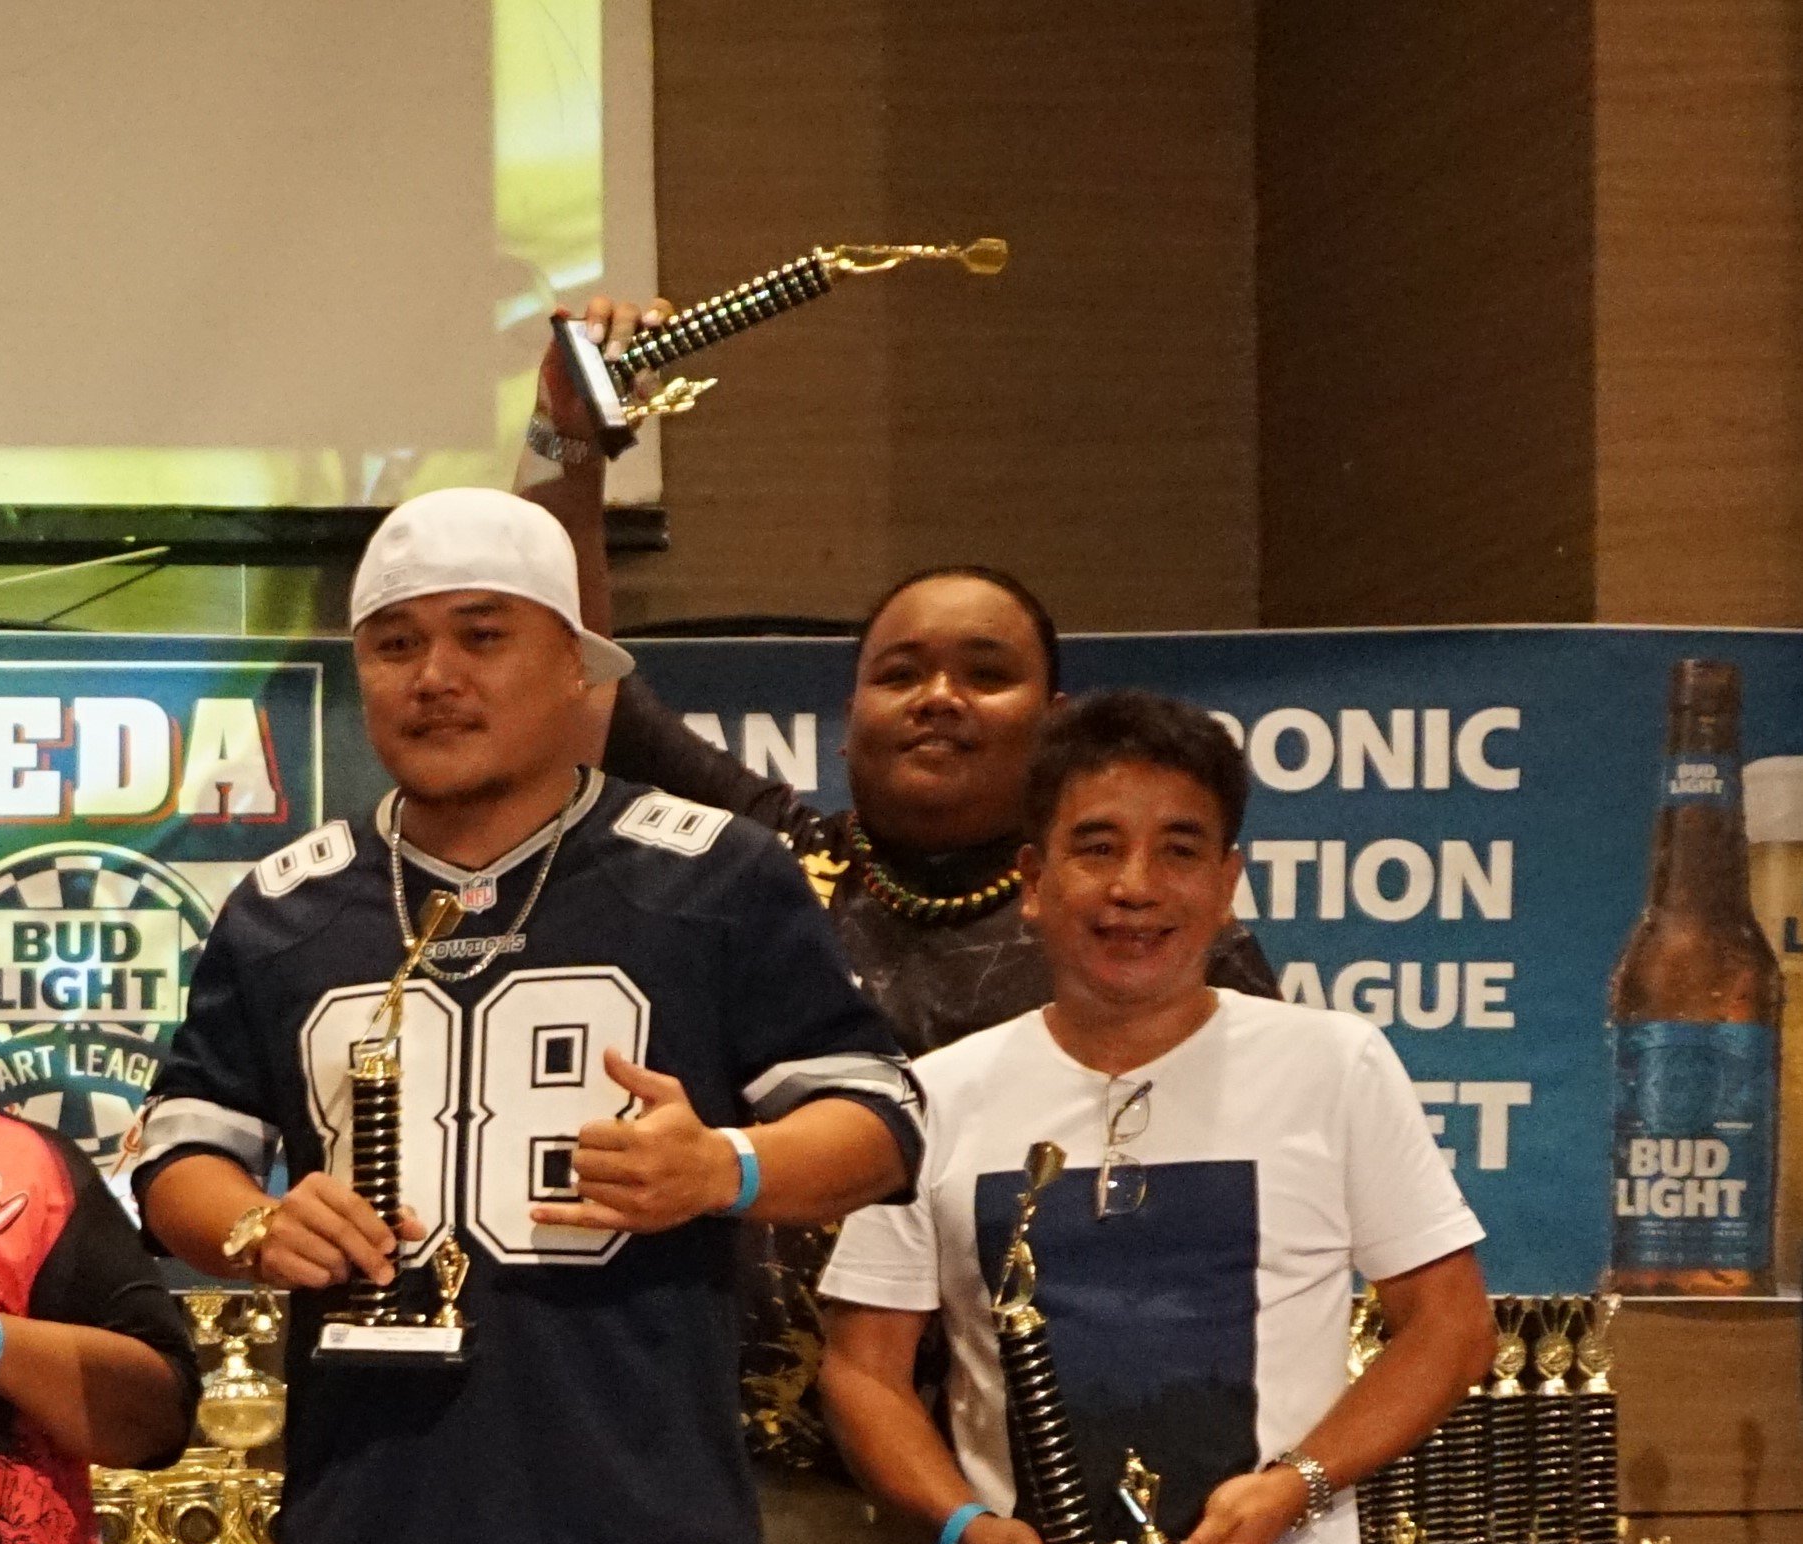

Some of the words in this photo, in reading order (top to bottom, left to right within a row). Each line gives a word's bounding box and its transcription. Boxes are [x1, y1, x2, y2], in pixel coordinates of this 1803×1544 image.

[1209, 706, 1522, 791] ONIC
[12, 920, 143, 963] BUD
[300, 966, 652, 1268] 88
[1629, 1138, 1731, 1178] BUD
[1615, 1177, 1748, 1219] LIGHT
